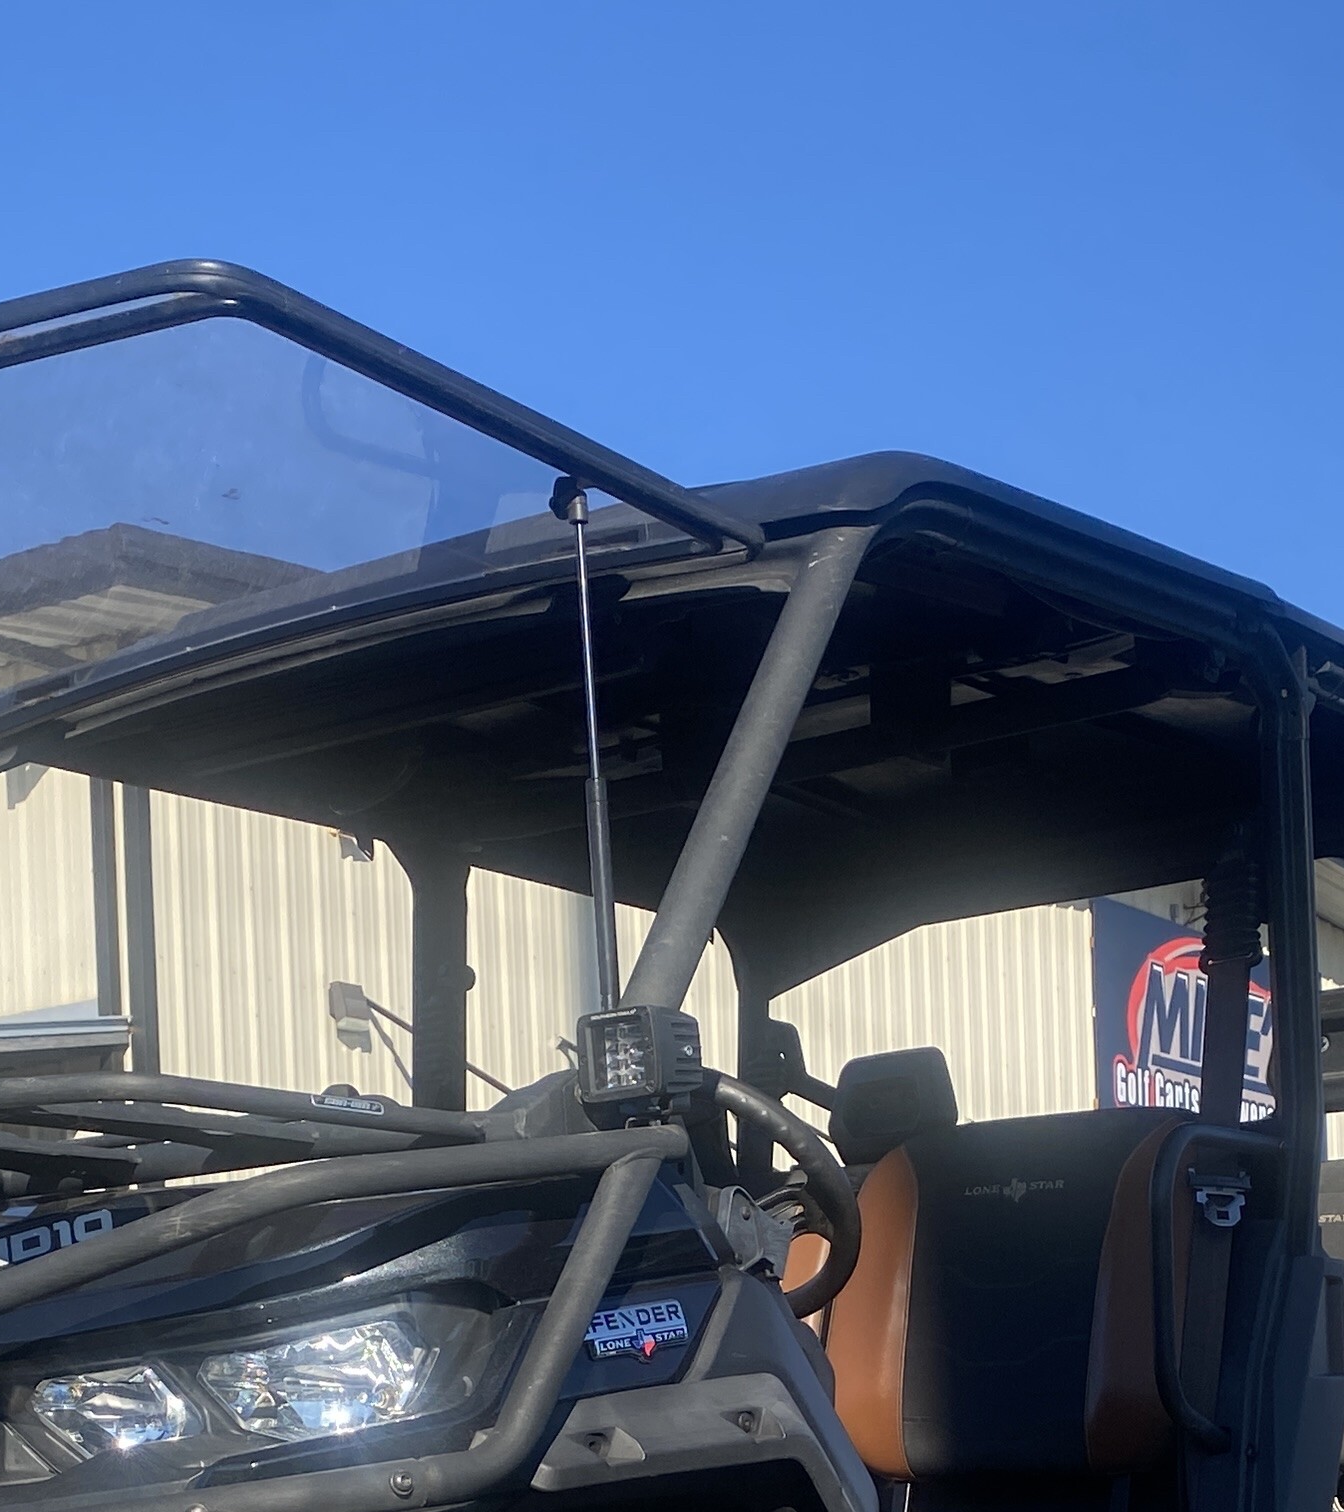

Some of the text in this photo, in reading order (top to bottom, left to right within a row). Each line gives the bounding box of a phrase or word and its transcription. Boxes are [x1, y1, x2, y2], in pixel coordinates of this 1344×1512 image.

[1137, 962, 1273, 1079] MIE'
[1116, 1062, 1151, 1107] Golf
[1154, 1070, 1202, 1114] Carts
[963, 1179, 1065, 1196] LONE STAR
[588, 1303, 682, 1334] FENDER
[600, 1329, 685, 1352] LONE STAR
